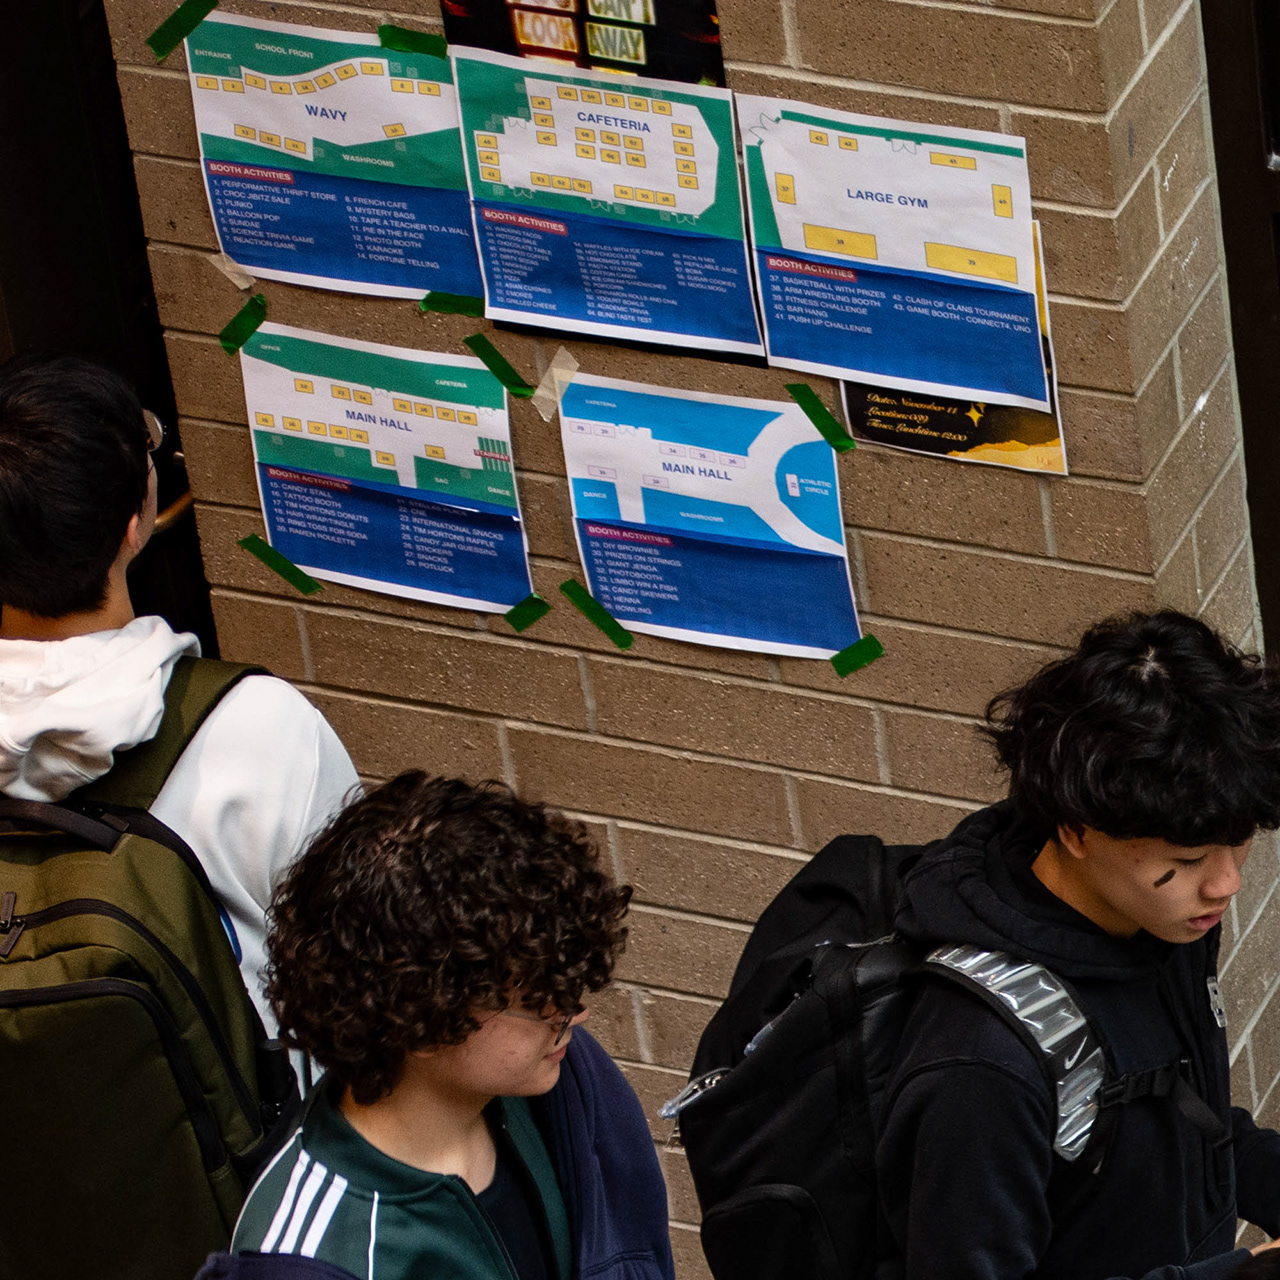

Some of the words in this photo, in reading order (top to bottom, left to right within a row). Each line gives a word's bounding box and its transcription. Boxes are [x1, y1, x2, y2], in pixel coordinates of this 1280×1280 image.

[517, 10, 576, 51] LOOK
[588, 23, 642, 60] AWAY
[194, 48, 232, 60] ENTRANCE
[254, 42, 287, 55] SCHOOL
[288, 47, 314, 60] FRONT
[305, 104, 347, 122] WAVY
[577, 111, 651, 133] CAFETERIA
[342, 153, 395, 168] WASHROOMS
[210, 163, 242, 174] BOOTH
[243, 168, 292, 181] ACTIVITIES
[221, 180, 281, 194] PERFORMATIVE
[282, 187, 310, 197] THRIFT
[310, 191, 338, 201] STORE
[223, 189, 246, 199] CROC
[271, 195, 291, 205] SALE
[847, 188, 895, 204] LARGE
[897, 194, 929, 209] GYM
[225, 199, 254, 209] PLINKO
[353, 196, 386, 206] FRENCH
[355, 206, 392, 217] MYSTERY
[393, 211, 416, 221] BAGS
[484, 210, 517, 222] BOOTH
[518, 216, 565, 232] ACTIVITIES
[360, 216, 381, 226] TAPE
[390, 219, 427, 231] TEACHER
[428, 224, 440, 232] TO
[448, 226, 470, 237] WALL
[362, 226, 375, 234] PIE
[376, 228, 385, 236] IN
[386, 229, 402, 238] THE
[403, 230, 425, 240] FACE
[769, 258, 803, 269] BOOTH
[804, 264, 854, 279] ACTIVITIES
[782, 276, 833, 291] BASKETBALL
[834, 285, 856, 294] WITH
[856, 288, 887, 299] PRIZES
[784, 286, 802, 294] ARM
[803, 289, 851, 303] WRESTLING
[851, 296, 881, 307] BOOTH
[785, 295, 819, 307] FITNESS
[820, 301, 868, 315] CHALLENGE
[905, 295, 932, 306] CLASH
[933, 300, 945, 308] OF
[946, 302, 973, 314] CLANS
[974, 307, 1030, 323] TOURNAMENT
[787, 314, 811, 324] PUSH
[811, 318, 824, 326] UP
[824, 319, 873, 334] CHALLENGE
[907, 305, 930, 316] GAME
[931, 310, 960, 320] BOOTH
[1013, 325, 1031, 333] UNO
[345, 409, 377, 425] MAIN
[379, 417, 412, 432] HALL
[268, 468, 300, 479] BOOTH
[301, 476, 349, 489] ACTIVITIES
[662, 462, 696, 477] MAIN
[698, 466, 733, 481] HALL
[800, 477, 832, 488] ATHLETIC
[284, 500, 298, 508] TIM
[299, 503, 336, 516] HORTONS
[337, 511, 369, 523] DONUTS
[412, 516, 472, 535] INTERNATIONAL
[472, 529, 504, 540] SNACKS
[588, 526, 621, 537] BOOTH
[622, 531, 670, 544] ACTIVITIES
[608, 568, 663, 581] PHOTOBOOTH
[611, 586, 639, 596] CANDY
[640, 590, 679, 601] SKEWERS
